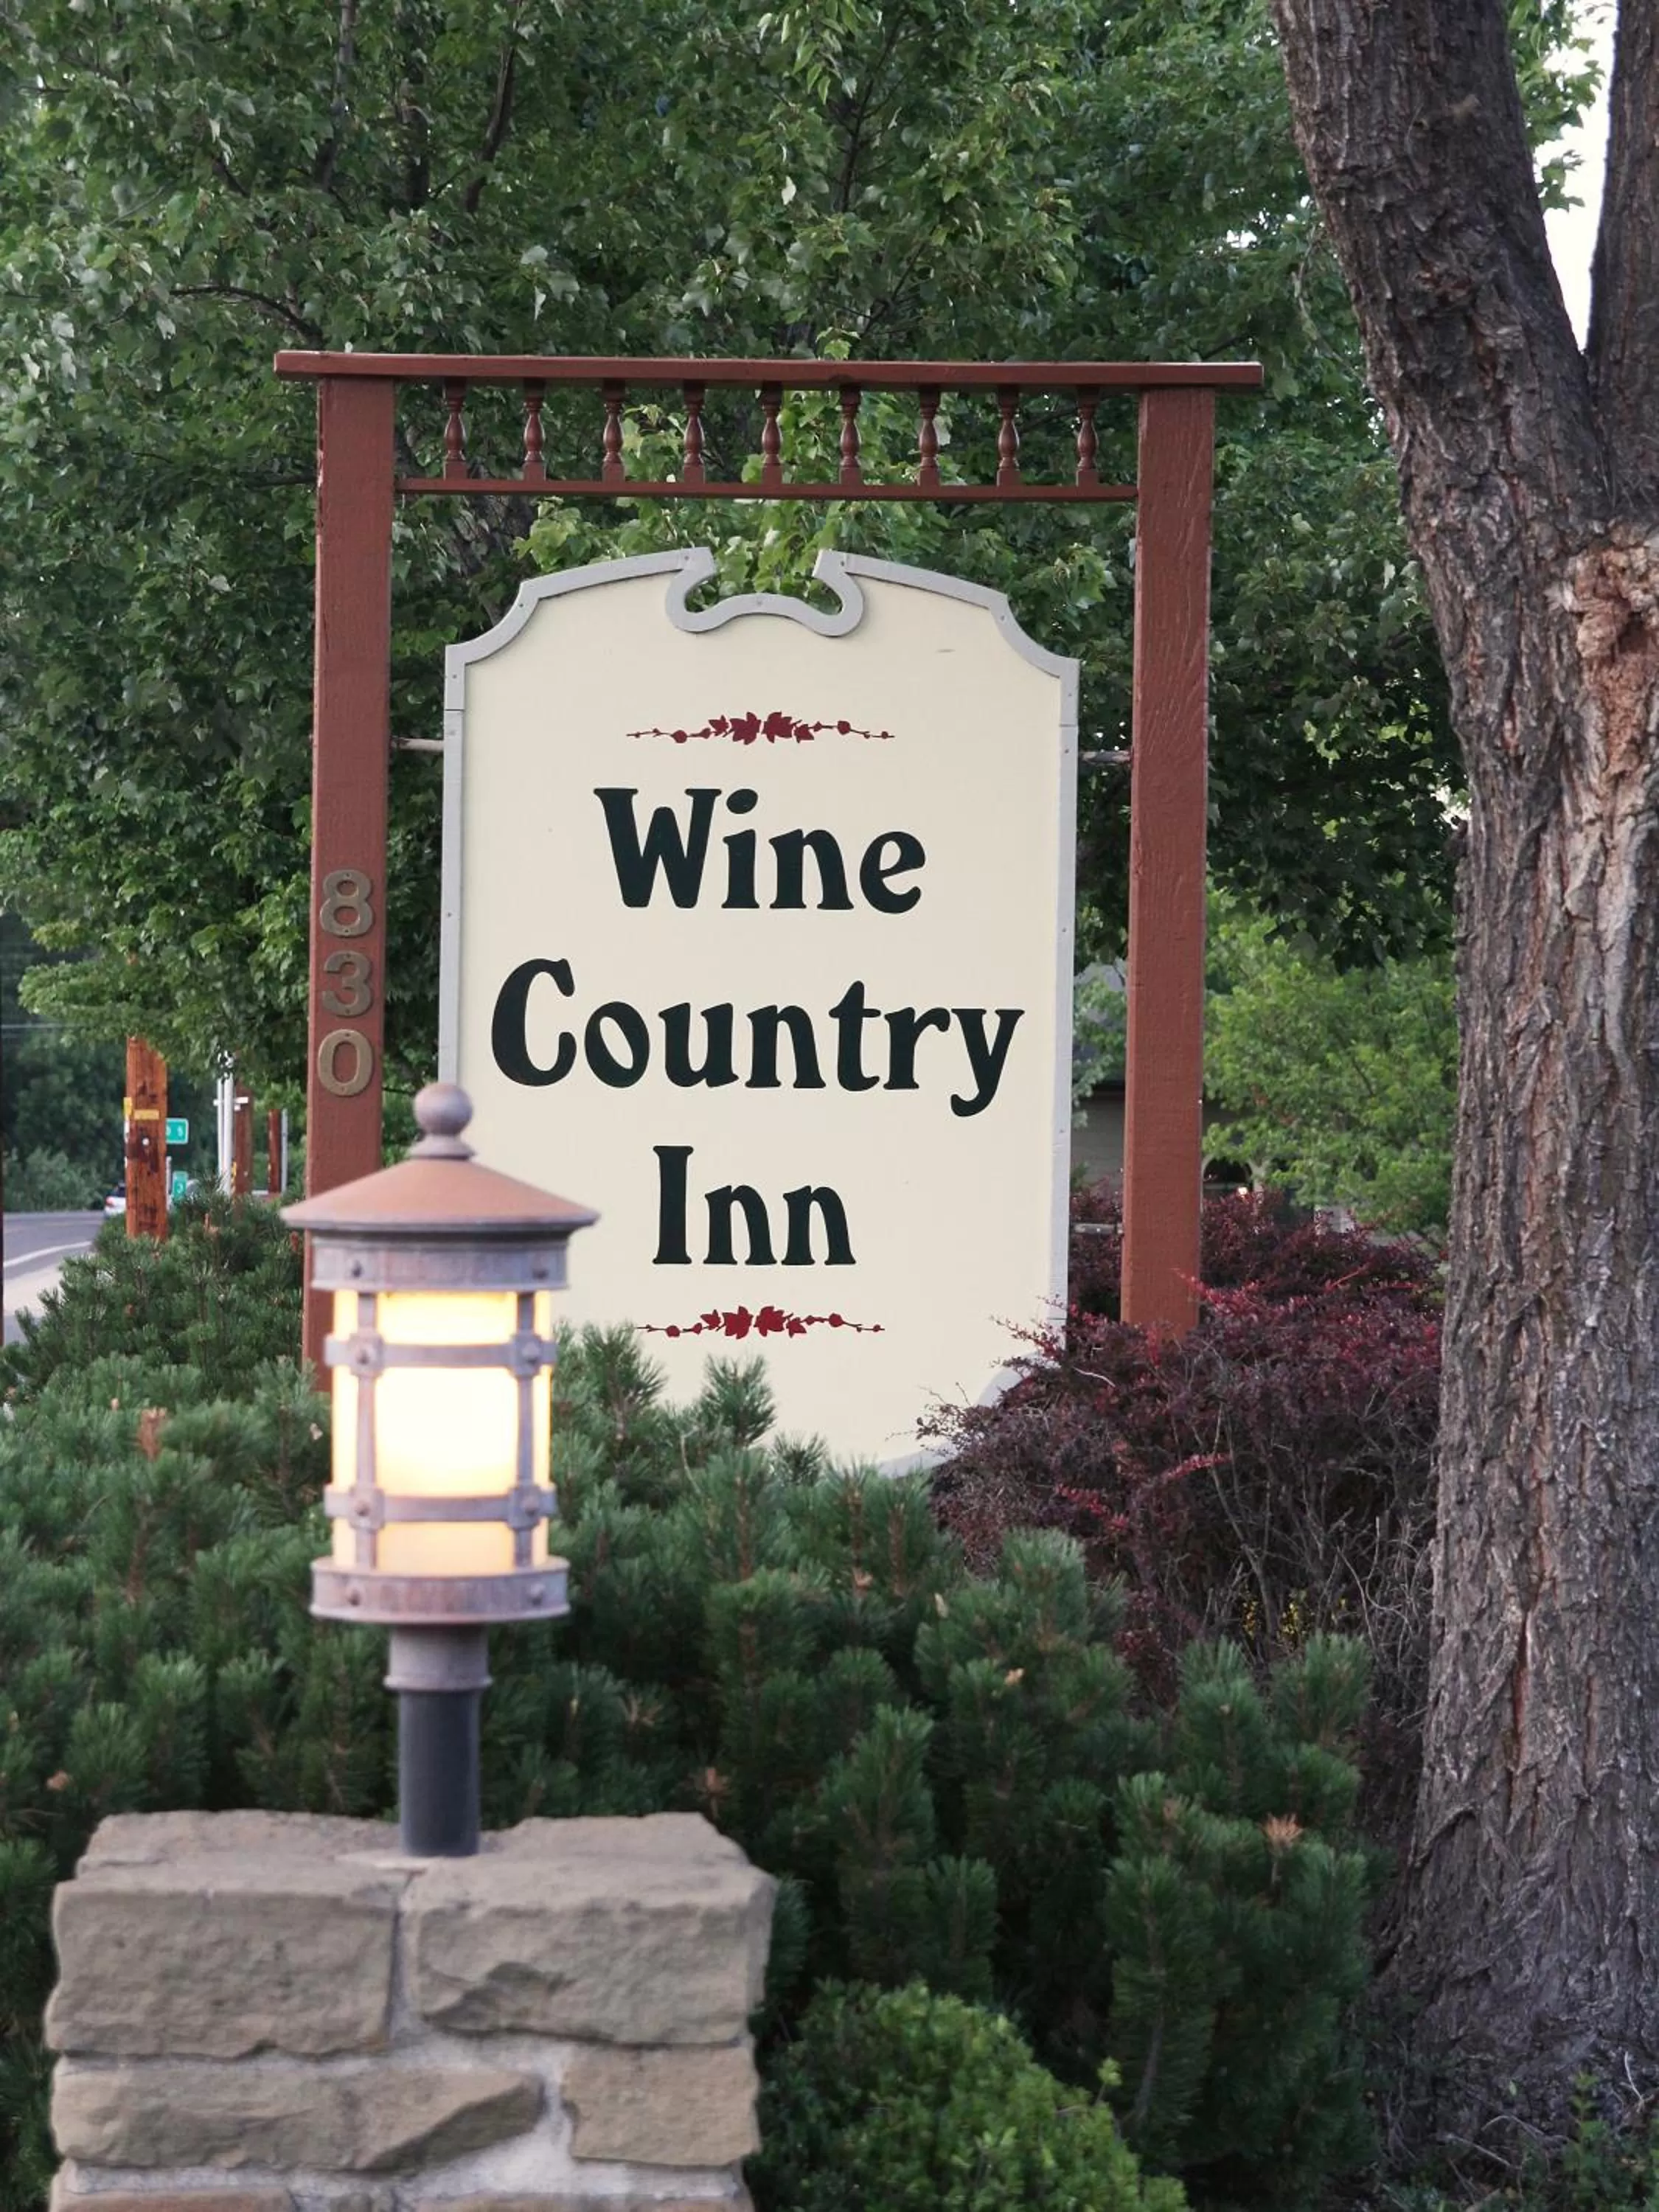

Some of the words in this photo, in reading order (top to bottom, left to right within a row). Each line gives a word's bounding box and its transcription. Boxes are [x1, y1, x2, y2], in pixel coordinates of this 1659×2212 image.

[594, 788, 925, 914] Wine
[318, 869, 374, 1096] 830
[492, 959, 1024, 1116] Country
[653, 1146, 855, 1265] Inn
